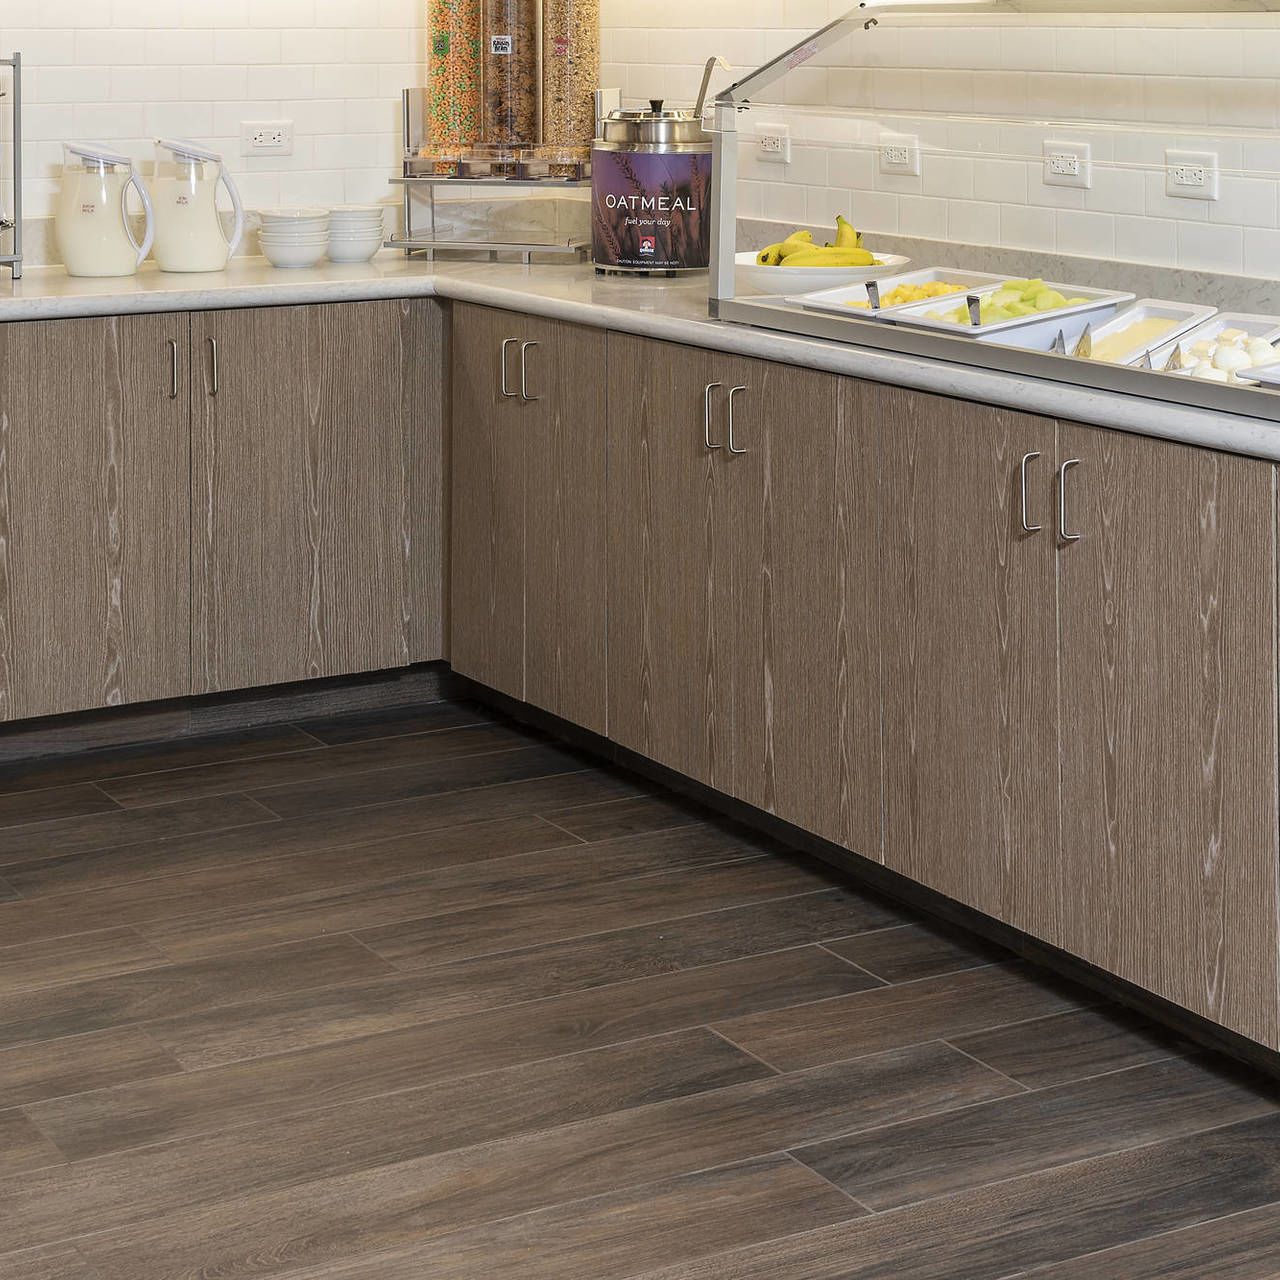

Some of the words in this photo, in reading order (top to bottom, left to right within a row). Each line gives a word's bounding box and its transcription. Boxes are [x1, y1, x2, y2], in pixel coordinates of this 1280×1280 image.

[605, 194, 697, 211] OATMEAL
[624, 216, 638, 226] fuel
[656, 218, 671, 227] day
